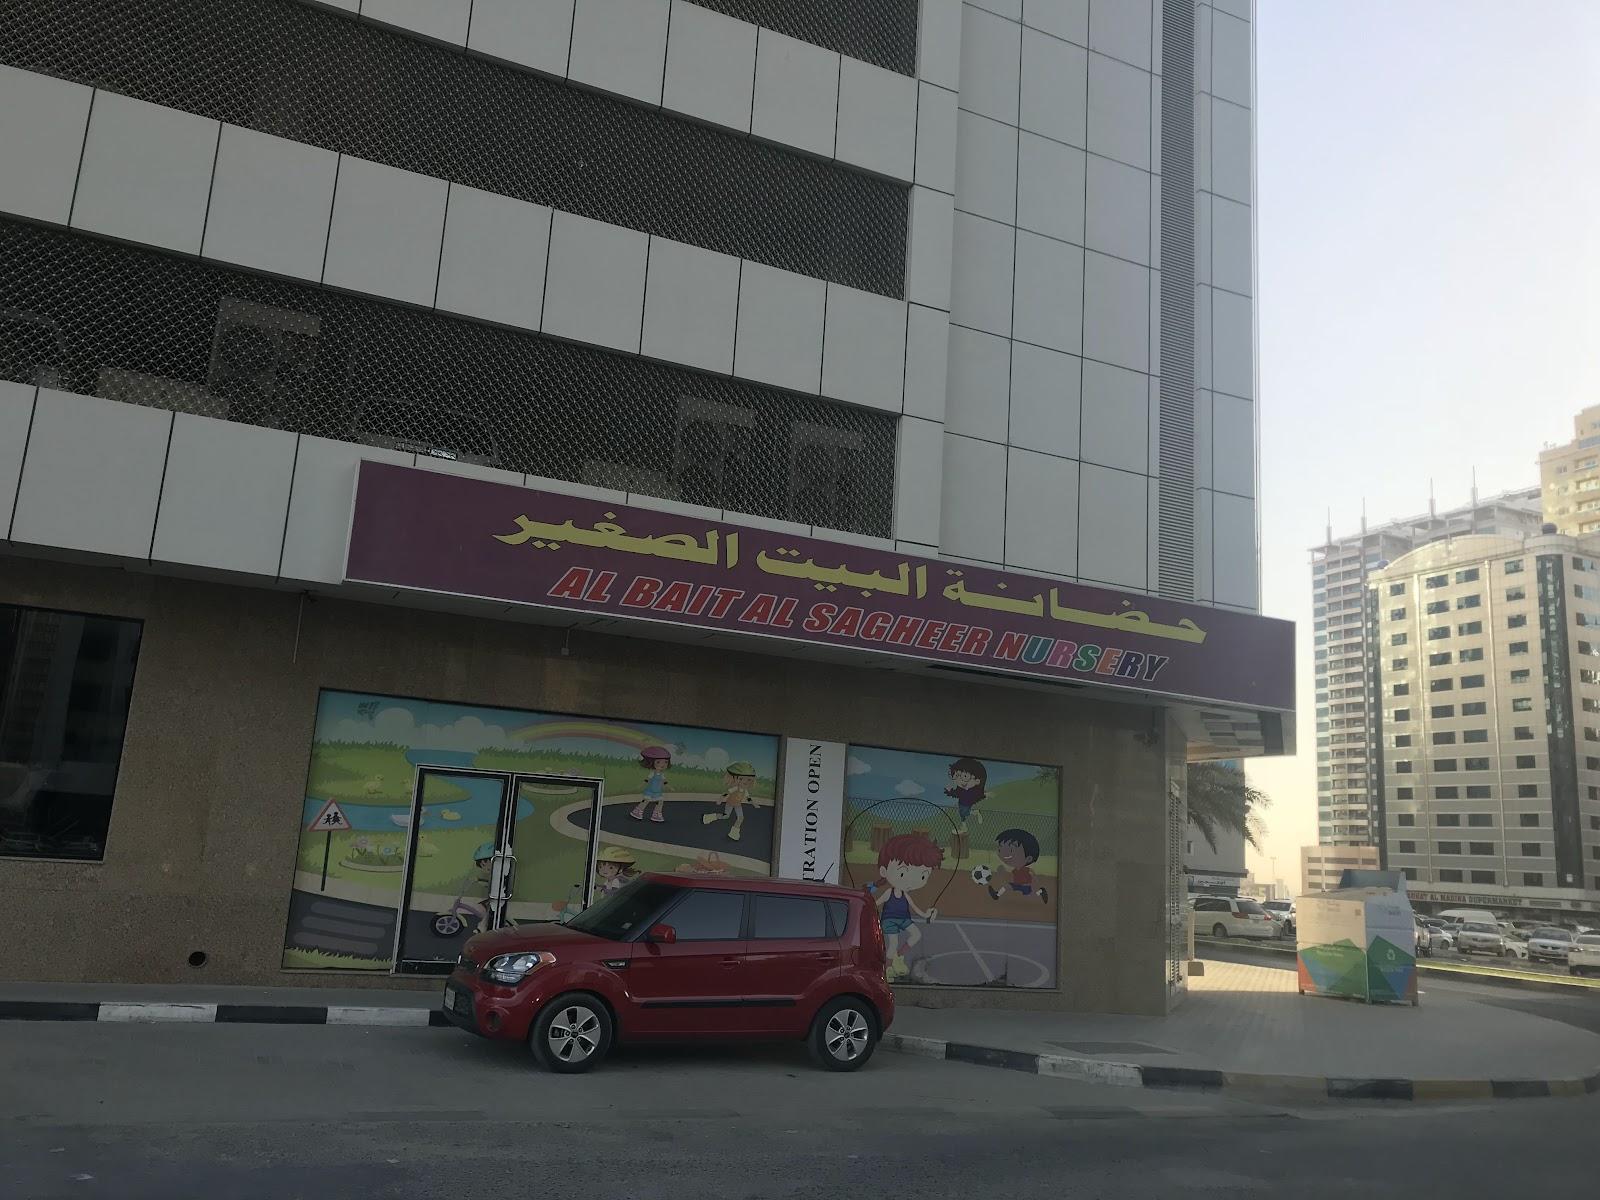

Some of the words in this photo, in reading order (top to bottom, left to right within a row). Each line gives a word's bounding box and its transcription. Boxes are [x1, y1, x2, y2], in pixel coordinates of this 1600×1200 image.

[492, 511, 740, 569] الصغير
[756, 547, 928, 599] البيت
[546, 567, 618, 603] AL
[620, 576, 745, 620] BAIT
[738, 594, 802, 629] AL
[803, 602, 992, 658] SAGHEER
[993, 631, 1170, 682] NURSERY
[942, 569, 1207, 645] حضانة
[807, 743, 822, 794] OPEN
